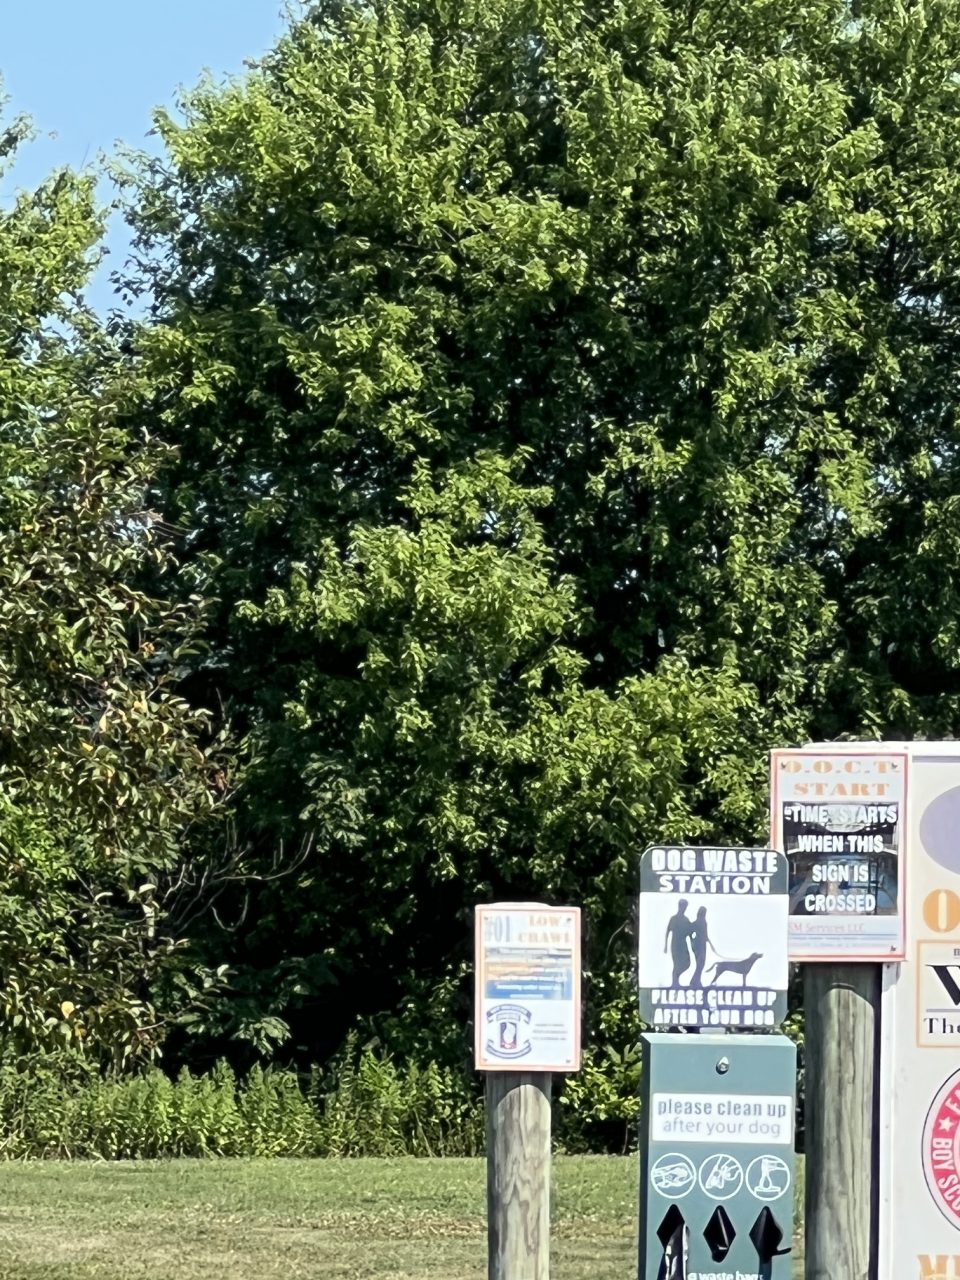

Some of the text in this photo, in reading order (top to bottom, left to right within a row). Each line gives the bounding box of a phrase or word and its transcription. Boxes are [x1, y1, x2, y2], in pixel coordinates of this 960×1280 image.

[793, 783, 890, 796] START
[839, 805, 897, 824] STARTS
[797, 834, 884, 853] WHEN THIS
[651, 849, 778, 873] DOG WASTE
[811, 864, 869, 883] SIGN IS
[659, 875, 771, 894] STATION
[804, 894, 876, 912] CROSSED
[651, 989, 777, 1006] PLEASE CLEAN UP
[653, 1008, 775, 1026] AFTER YOUR DOG
[657, 1099, 787, 1118] please clean up
[662, 1117, 781, 1138] after your dog
[932, 1137, 955, 1171] BOY
